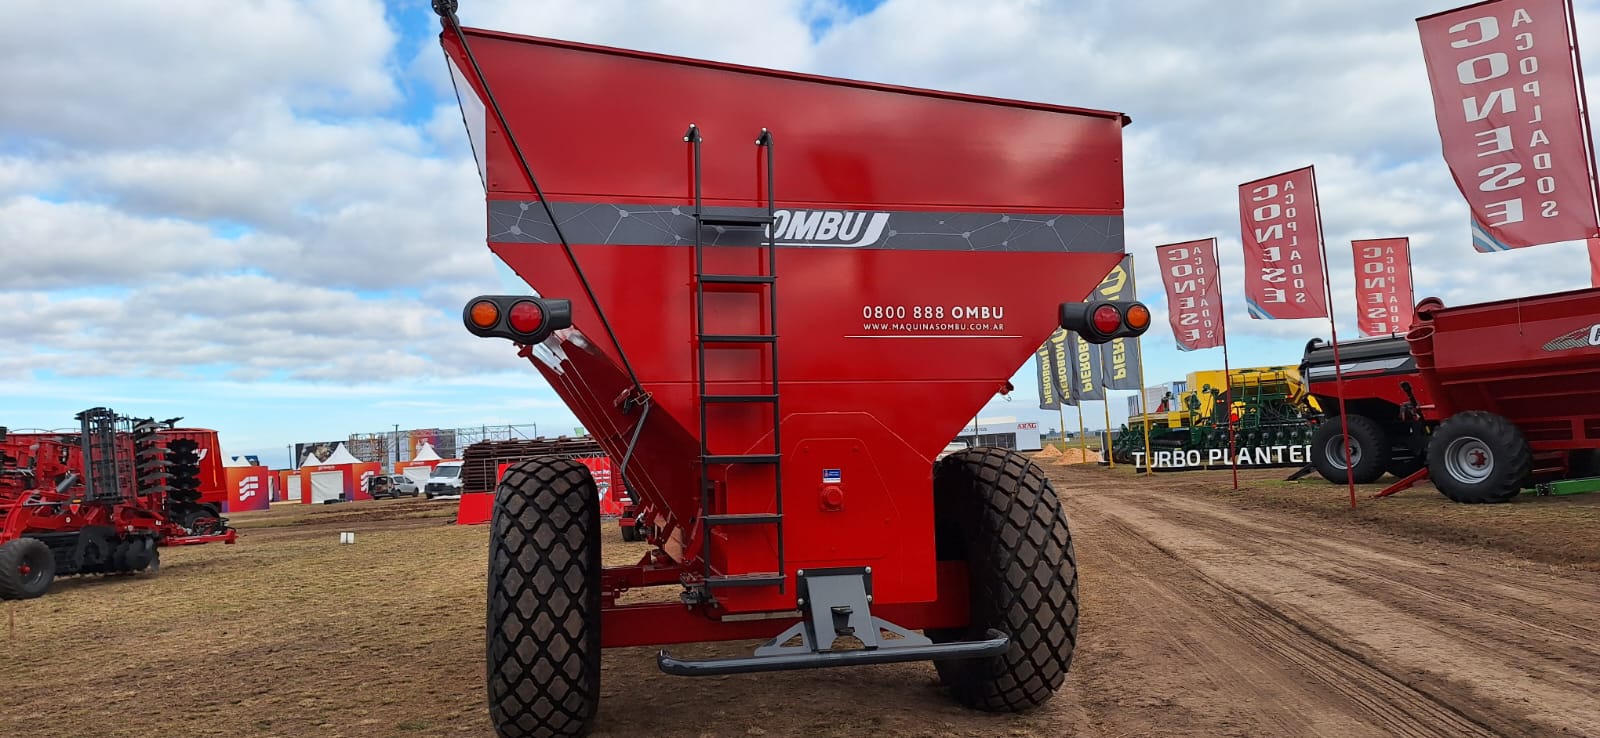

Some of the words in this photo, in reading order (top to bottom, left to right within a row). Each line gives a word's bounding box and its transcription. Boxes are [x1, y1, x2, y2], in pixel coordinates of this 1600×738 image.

[764, 209, 867, 241] OMBU
[863, 305, 906, 319] 0800
[913, 306, 944, 319] 888
[951, 306, 1004, 319] OMBU
[863, 323, 1004, 331] WWW.MAQUINASOMBU.COM.AR
[1131, 449, 1201, 469] TURBO
